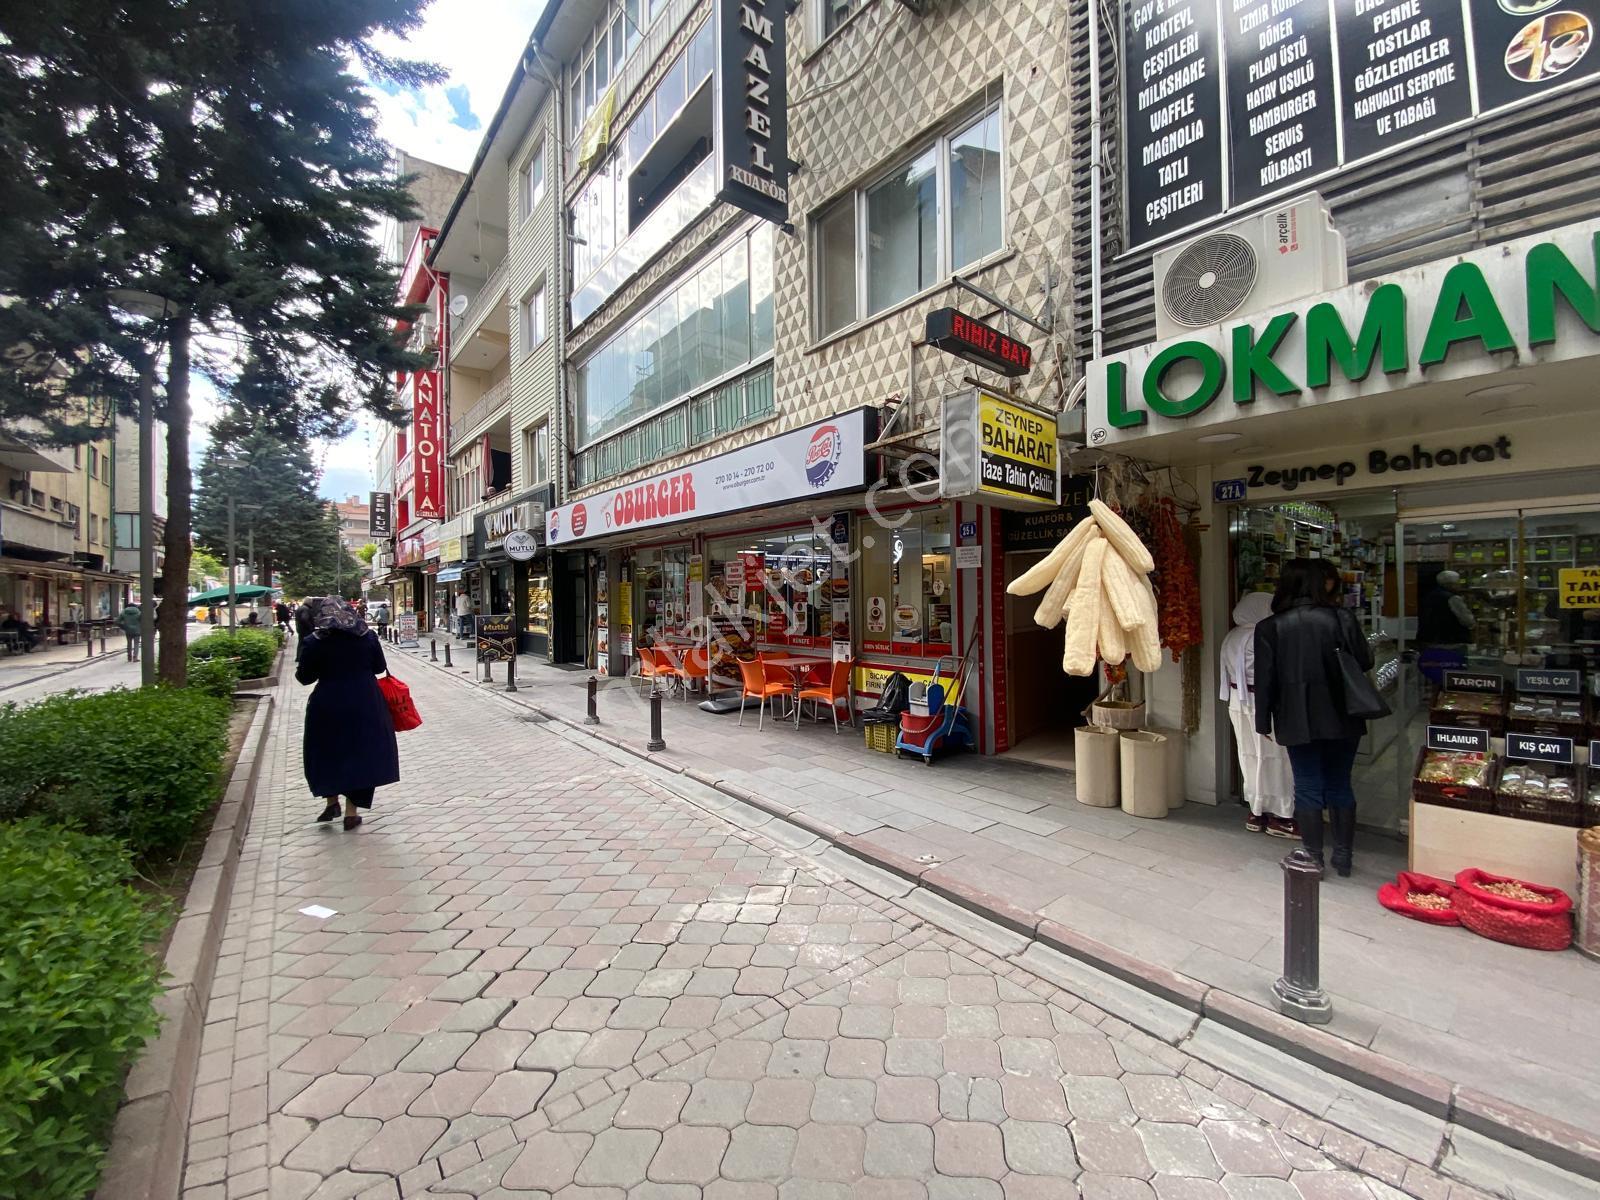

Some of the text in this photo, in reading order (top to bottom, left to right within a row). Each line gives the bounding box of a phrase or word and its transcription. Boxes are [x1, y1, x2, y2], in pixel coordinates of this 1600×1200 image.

[1134, 0, 1154, 32] ÇAY
[1145, 6, 1194, 51] KOKTEYL
[1259, 17, 1293, 51] DÖNER
[1373, 0, 1421, 34] PENNE
[1279, 34, 1307, 67] ÜSTÜ
[1367, 18, 1432, 61] TOSTLAR
[1246, 58, 1315, 112] HATAY USULÜ
[1354, 38, 1450, 93] GÖZLEMELER
[741, 3, 774, 174] MAZEL
[1354, 62, 1456, 120] KAHVALTI SERPME
[1150, 93, 1194, 132] WAFFLE
[1249, 89, 1317, 137] HAMBURGER
[1376, 96, 1436, 136] VE TABAĞI
[730, 163, 787, 203] KUAFÖR
[1158, 156, 1188, 188] TATLI
[1260, 147, 1312, 187] KÜLBASTI
[1146, 180, 1203, 226] ÇEŞİTLERİ
[1105, 230, 1600, 429] LOKMAN
[996, 407, 1043, 436] ZEYNEP
[982, 422, 1053, 465] BAHARAT
[1247, 434, 1512, 491] Zeynep Baharat
[715, 475, 726, 485] 270
[744, 467, 756, 477] 270
[982, 458, 1053, 493] Taze Tahin Çekilir
[614, 472, 696, 527] OBURGER
[1025, 511, 1065, 526] KUAFÖR
[1452, 677, 1496, 688] TARÇIN
[1525, 675, 1571, 687] YEŞİL ÇAY
[1436, 733, 1479, 745] IHLAMUR
[1519, 741, 1560, 754] KIŞ ÇAYI
